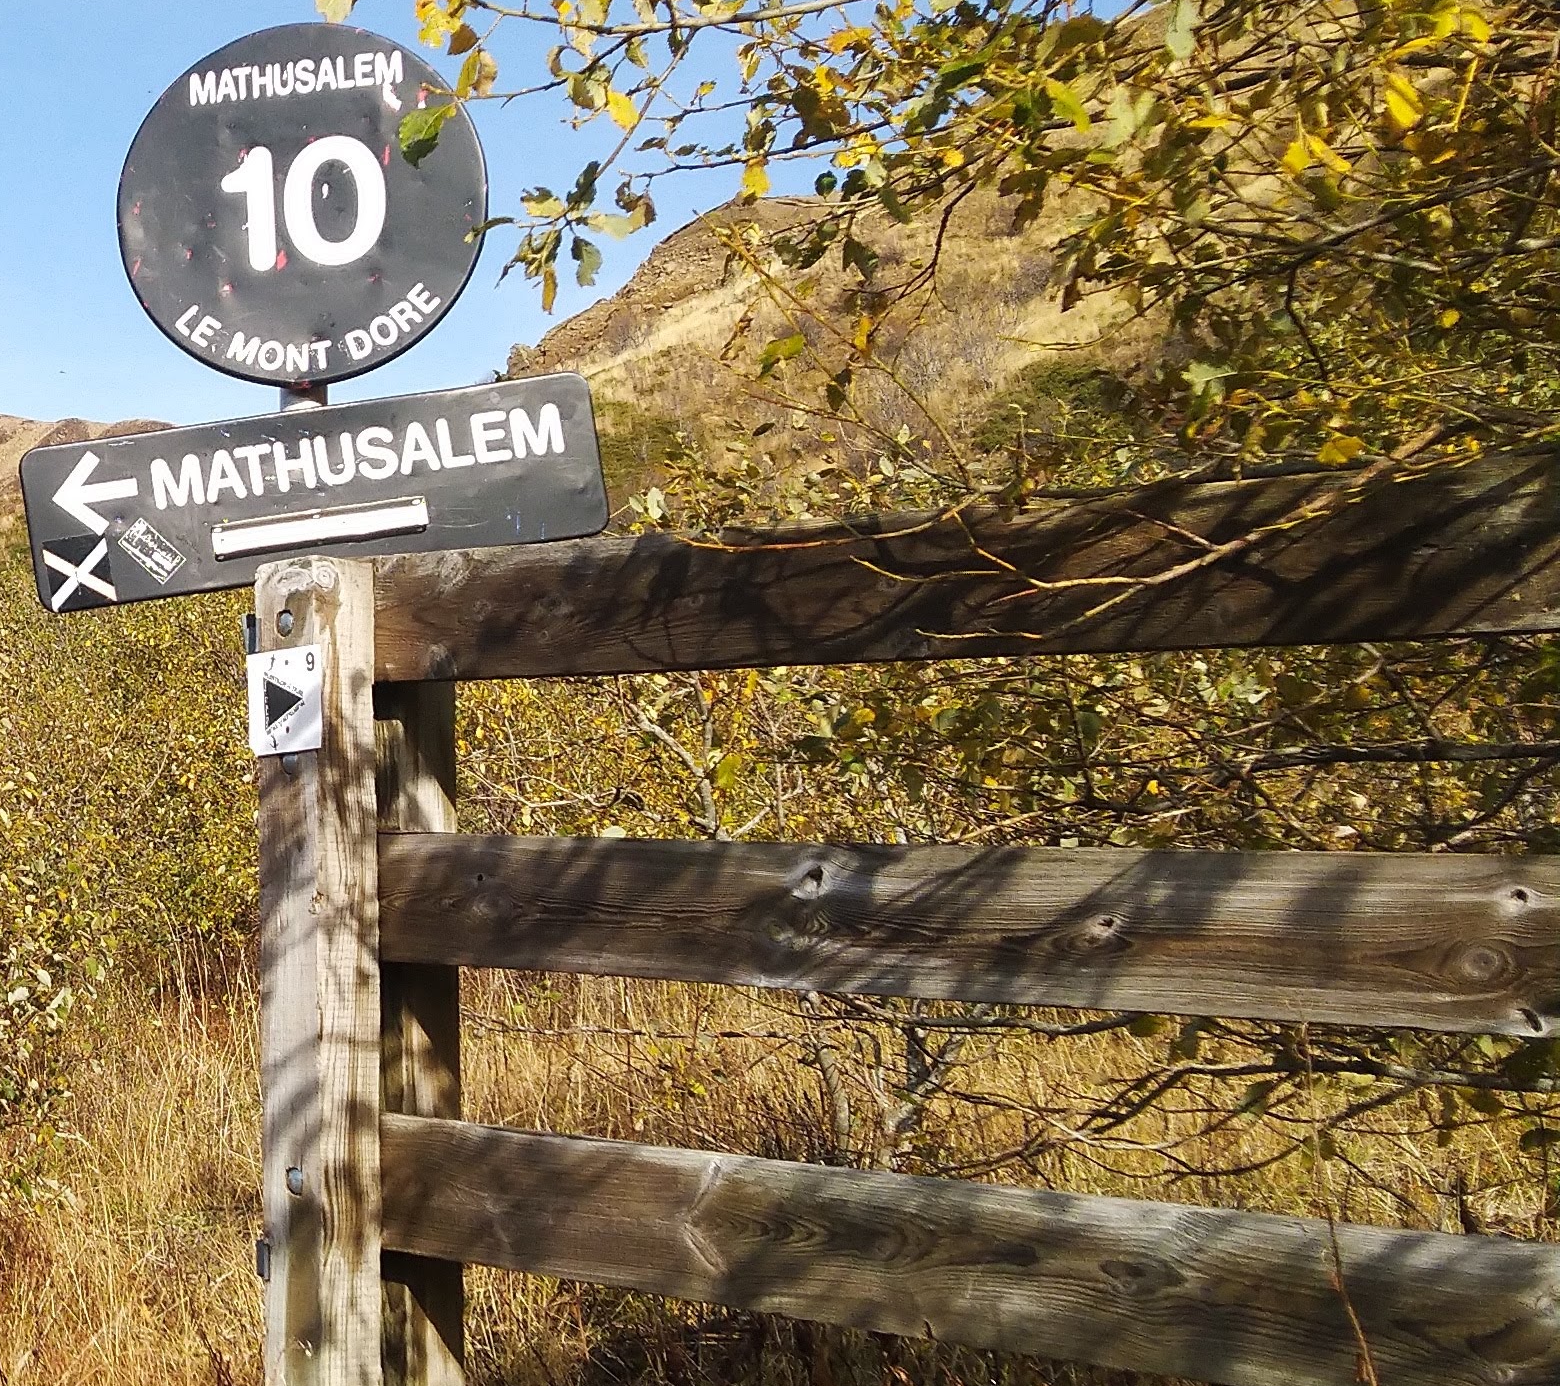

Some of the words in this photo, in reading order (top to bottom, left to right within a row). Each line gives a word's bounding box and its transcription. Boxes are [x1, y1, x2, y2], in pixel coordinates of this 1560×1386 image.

[188, 51, 403, 107] MATHUSALEM
[220, 134, 388, 272] 10
[173, 304, 221, 348] LE
[226, 339, 332, 373] MONT
[346, 282, 442, 361] DORE
[149, 402, 566, 510] MATHUSALEM
[305, 651, 315, 672] 9
